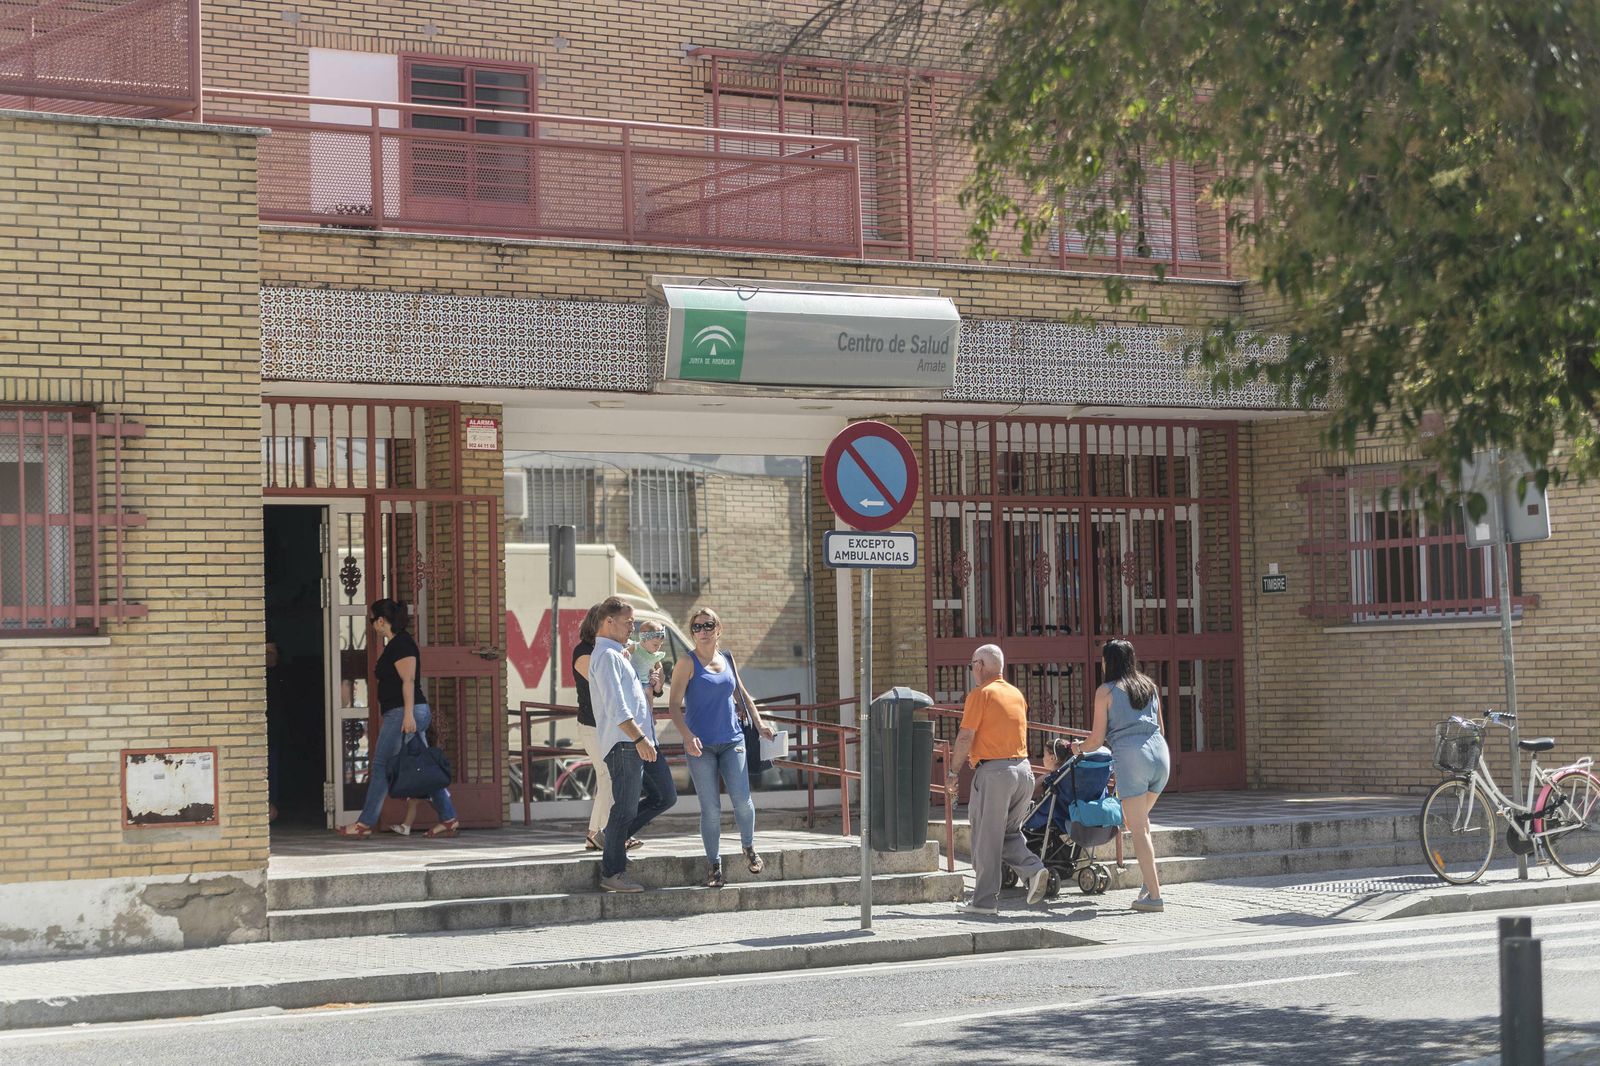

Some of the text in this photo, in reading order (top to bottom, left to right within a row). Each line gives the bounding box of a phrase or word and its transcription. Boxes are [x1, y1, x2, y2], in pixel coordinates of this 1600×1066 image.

[837, 332, 950, 355] Centro de Salud
[917, 359, 947, 373] Amate
[848, 538, 895, 549] EXCEPTO
[834, 550, 910, 562] AMBULANCIAS
[1263, 578, 1286, 590] TIMBRE
